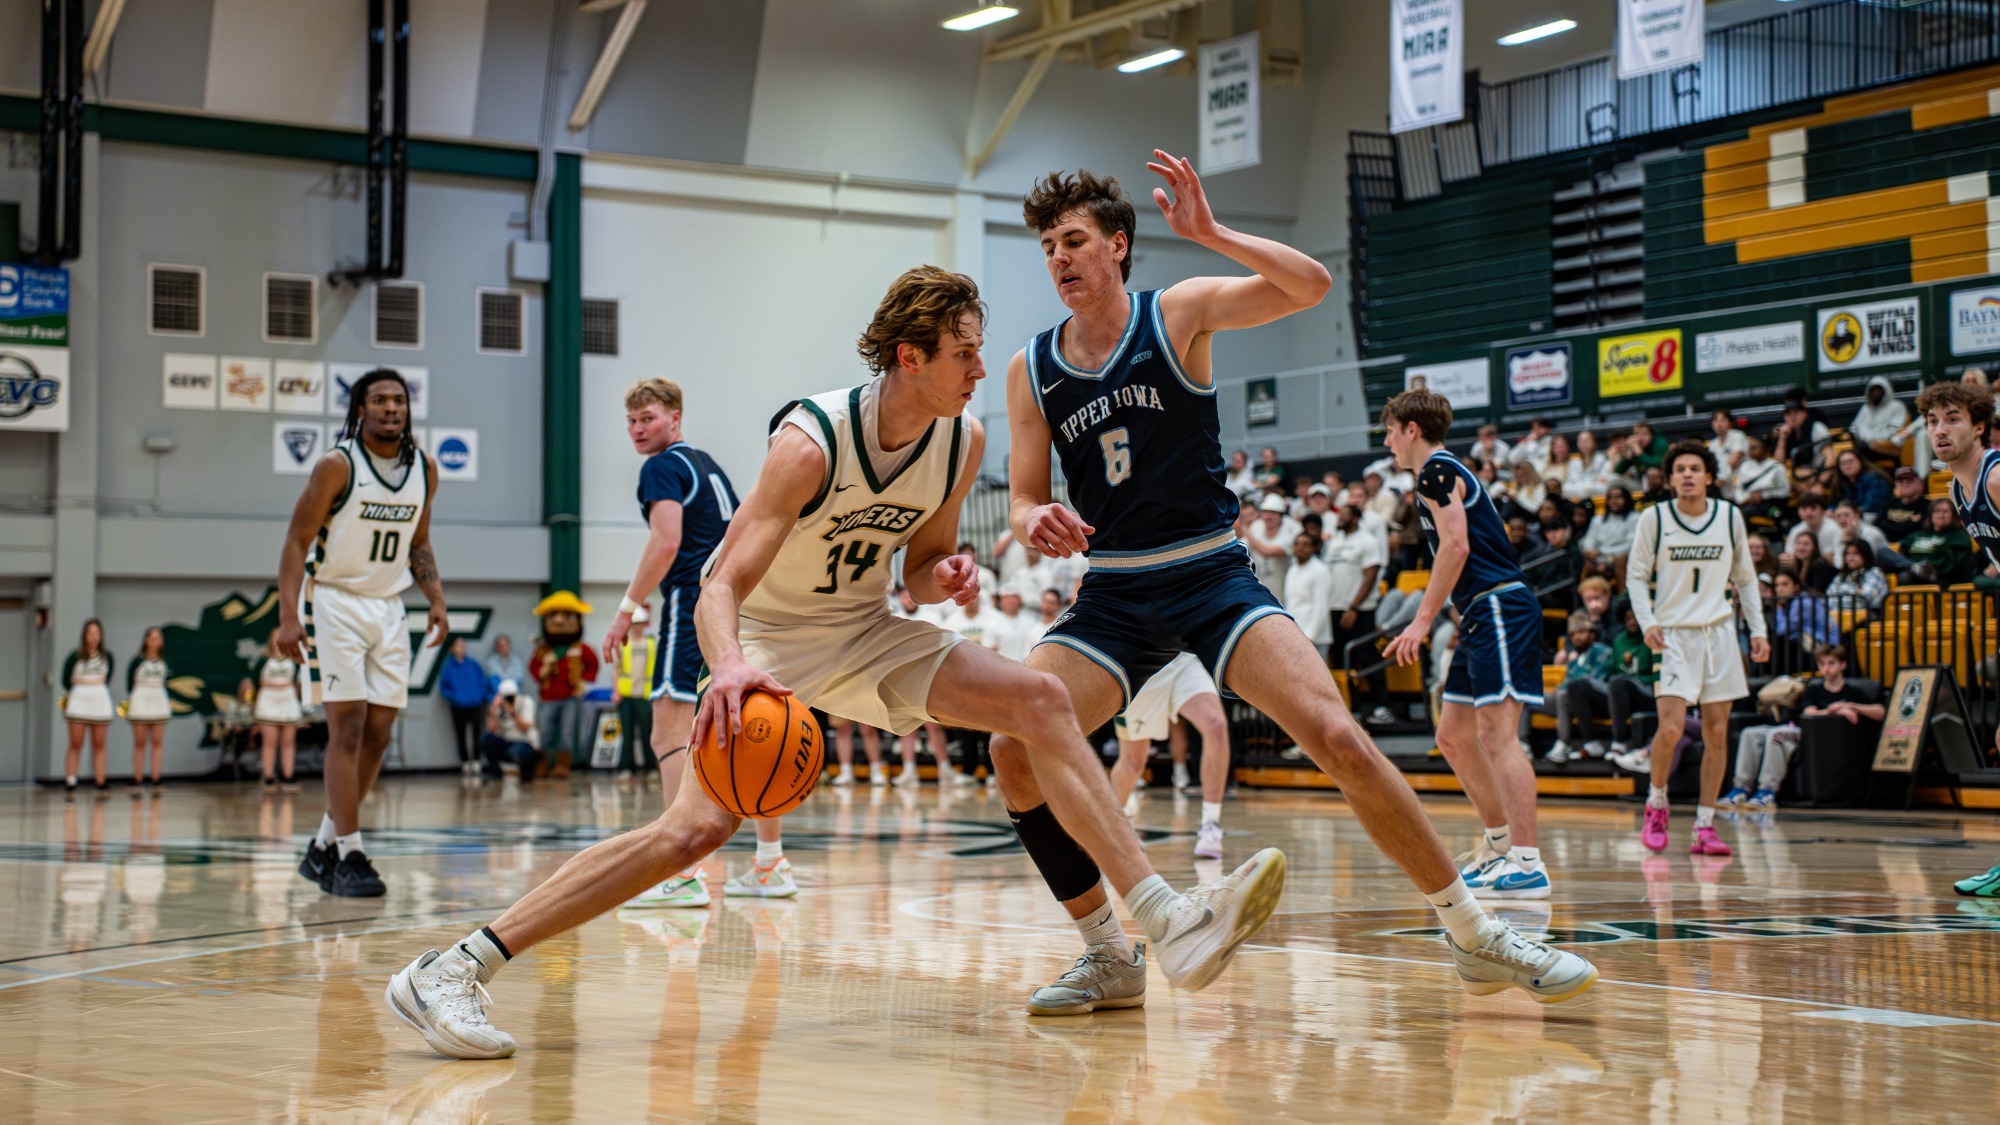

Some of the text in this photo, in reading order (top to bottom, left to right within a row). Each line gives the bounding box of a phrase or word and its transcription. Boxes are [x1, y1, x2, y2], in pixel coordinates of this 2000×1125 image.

[1868, 319, 1915, 339] WILD
[1868, 336, 1915, 356] WINGS
[1650, 338, 1678, 385] 8
[1060, 384, 1165, 443] UPPER IOWA
[1098, 426, 1132, 487] 6
[363, 503, 416, 521] MINERS
[369, 530, 400, 562] 10
[1671, 546, 1721, 560] MINERS
[813, 540, 881, 594] 34
[1692, 567, 1700, 593] 1
